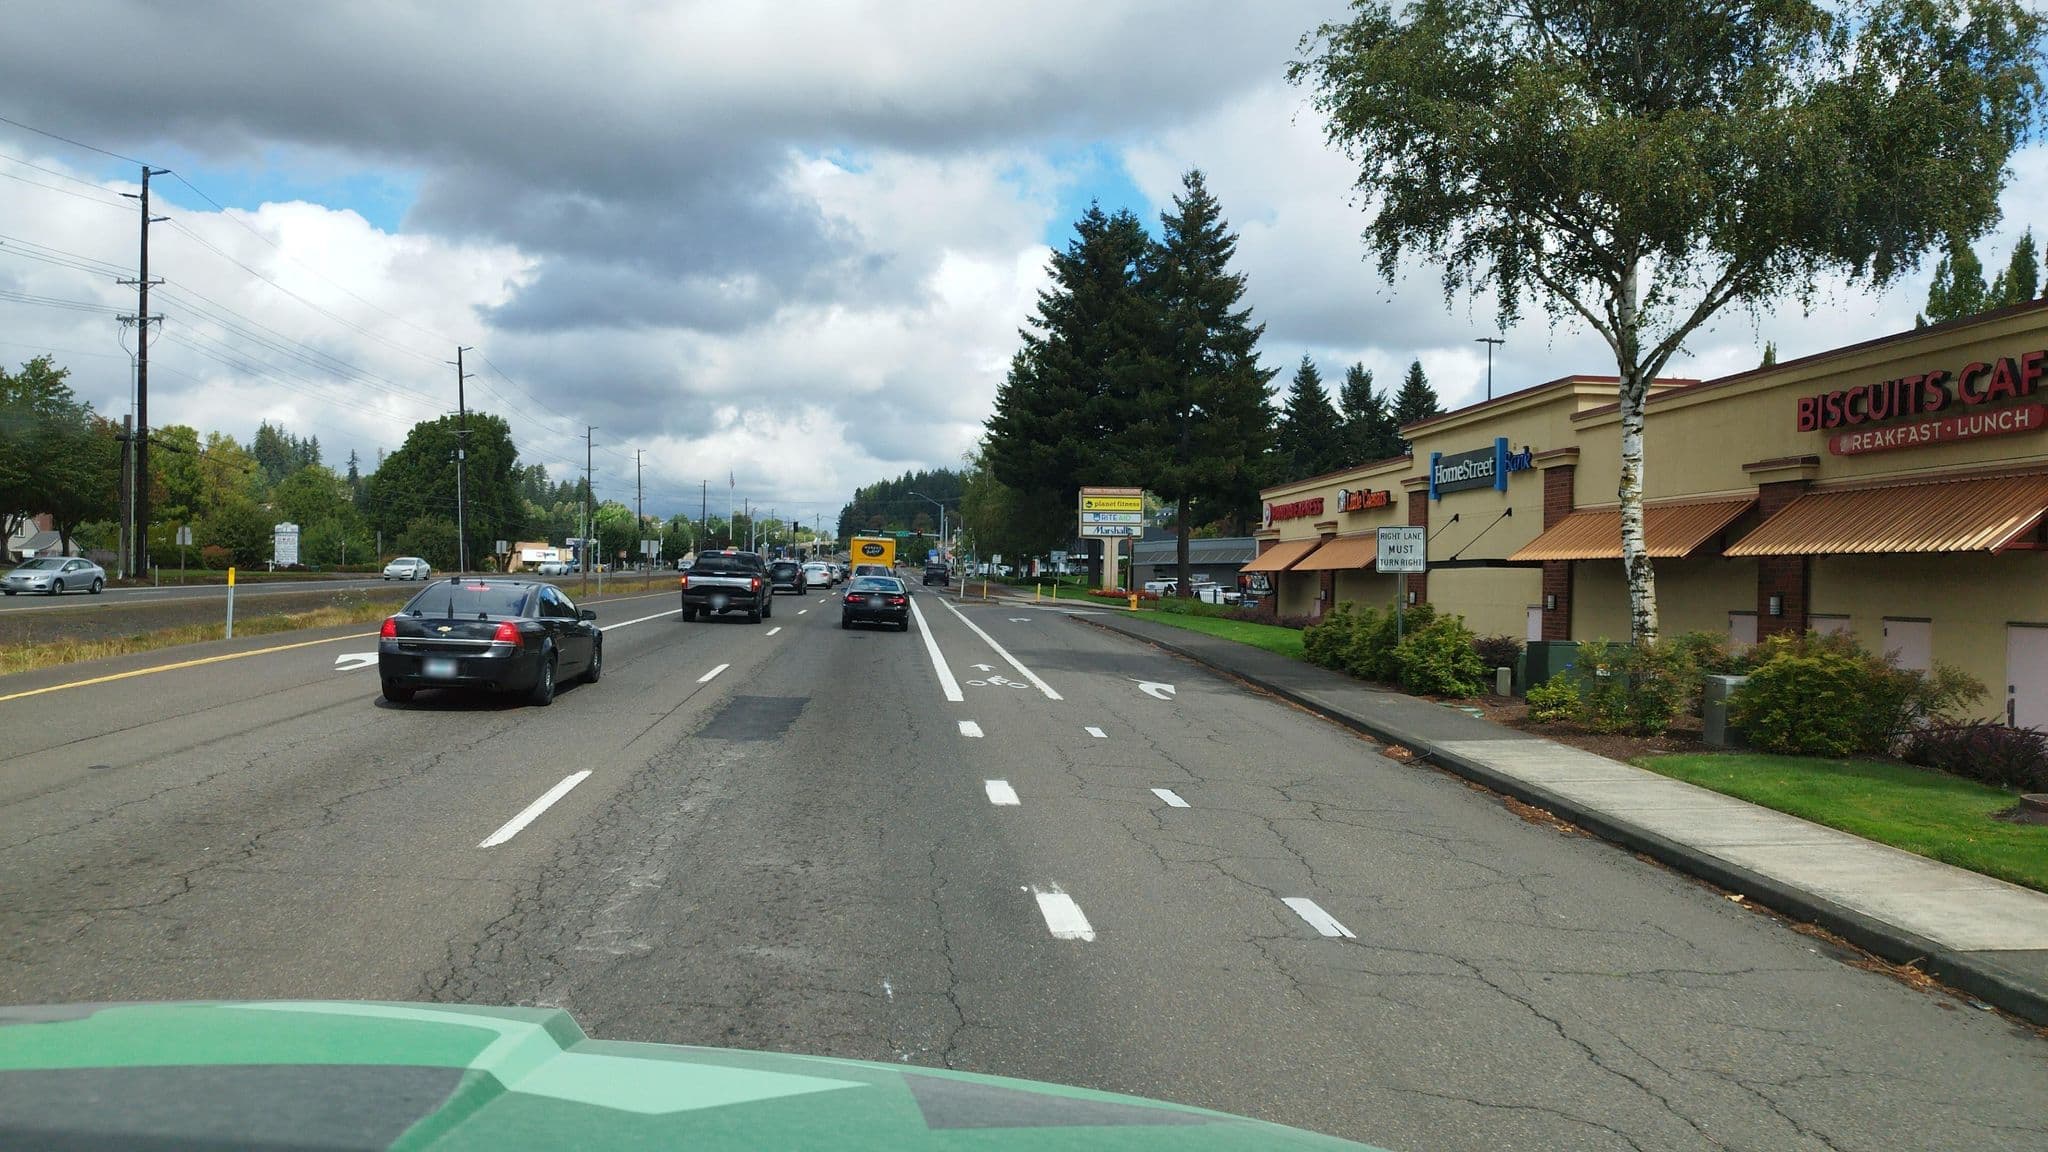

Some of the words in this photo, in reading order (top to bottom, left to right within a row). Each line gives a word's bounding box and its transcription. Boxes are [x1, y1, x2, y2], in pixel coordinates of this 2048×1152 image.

[1797, 370, 1951, 432] BISCUITS
[1957, 408, 2029, 436] LUNCH
[1435, 456, 1494, 484] HomeStreet
[1504, 446, 1532, 473] Bank
[1380, 532, 1400, 540] RIGHT
[1403, 532, 1422, 540] LANE
[1388, 544, 1413, 555] MUST
[1380, 558, 1399, 567] TURN
[1400, 558, 1422, 567] RIGHT
